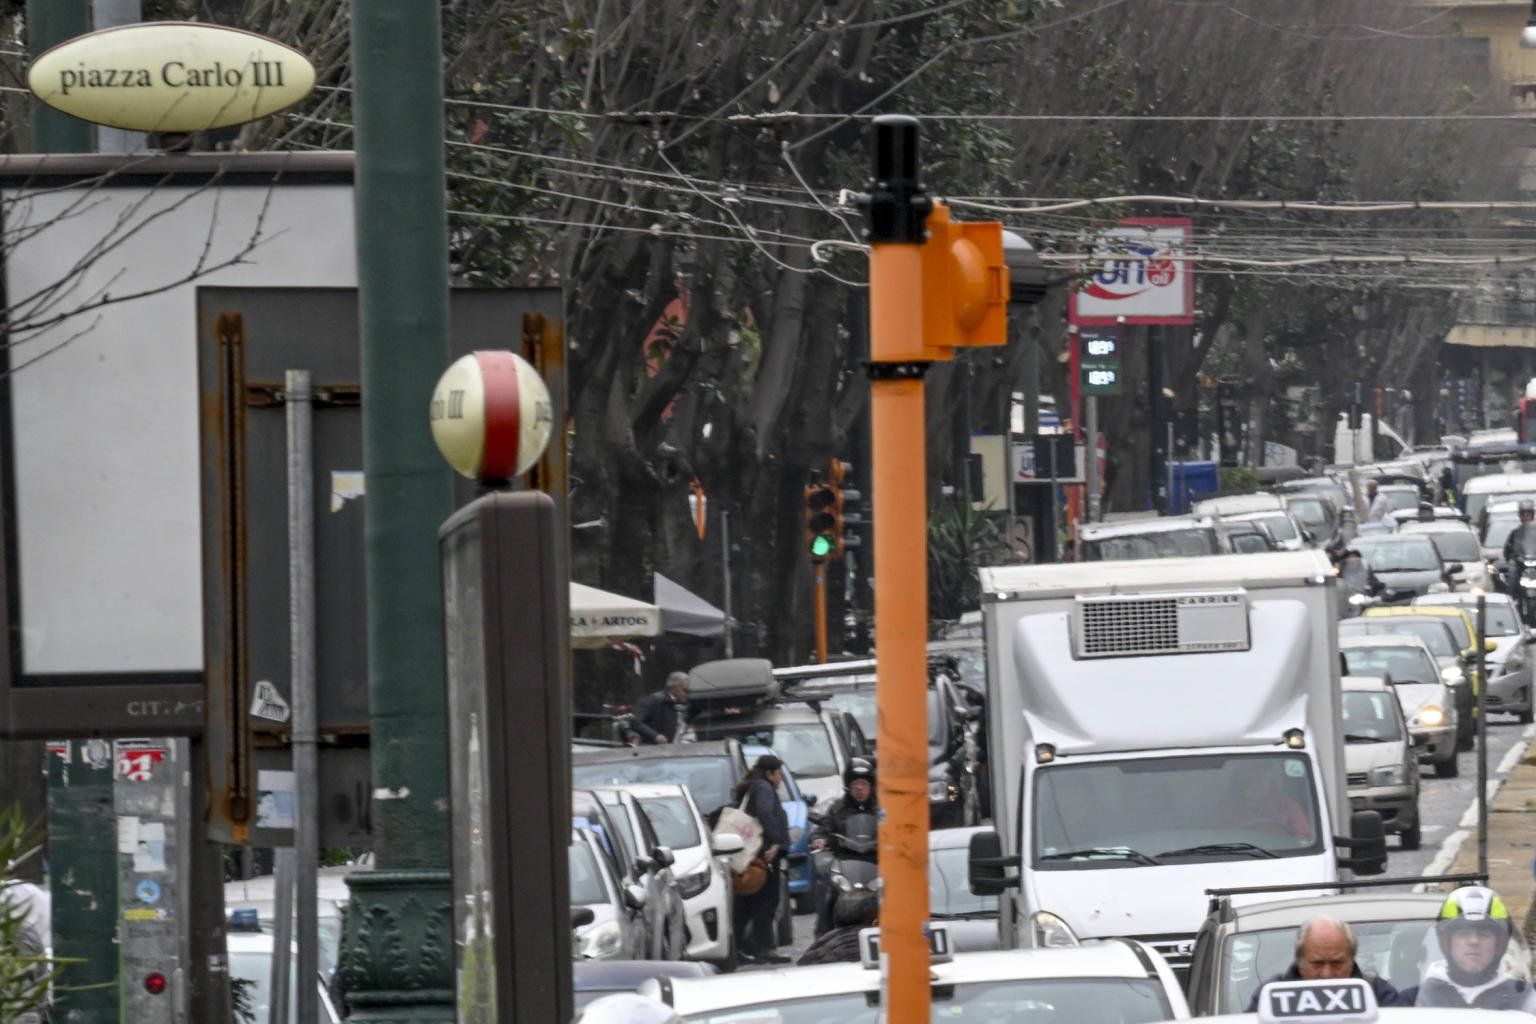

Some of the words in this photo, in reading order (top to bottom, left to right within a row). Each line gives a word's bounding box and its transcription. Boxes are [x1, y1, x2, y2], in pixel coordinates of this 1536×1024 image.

[60, 62, 152, 94] piazza
[161, 61, 242, 87] Carlo
[251, 61, 285, 87] III
[1178, 595, 1239, 605] CARRIER
[601, 615, 648, 627] ARTOIS
[1271, 988, 1361, 1013] TAXI
